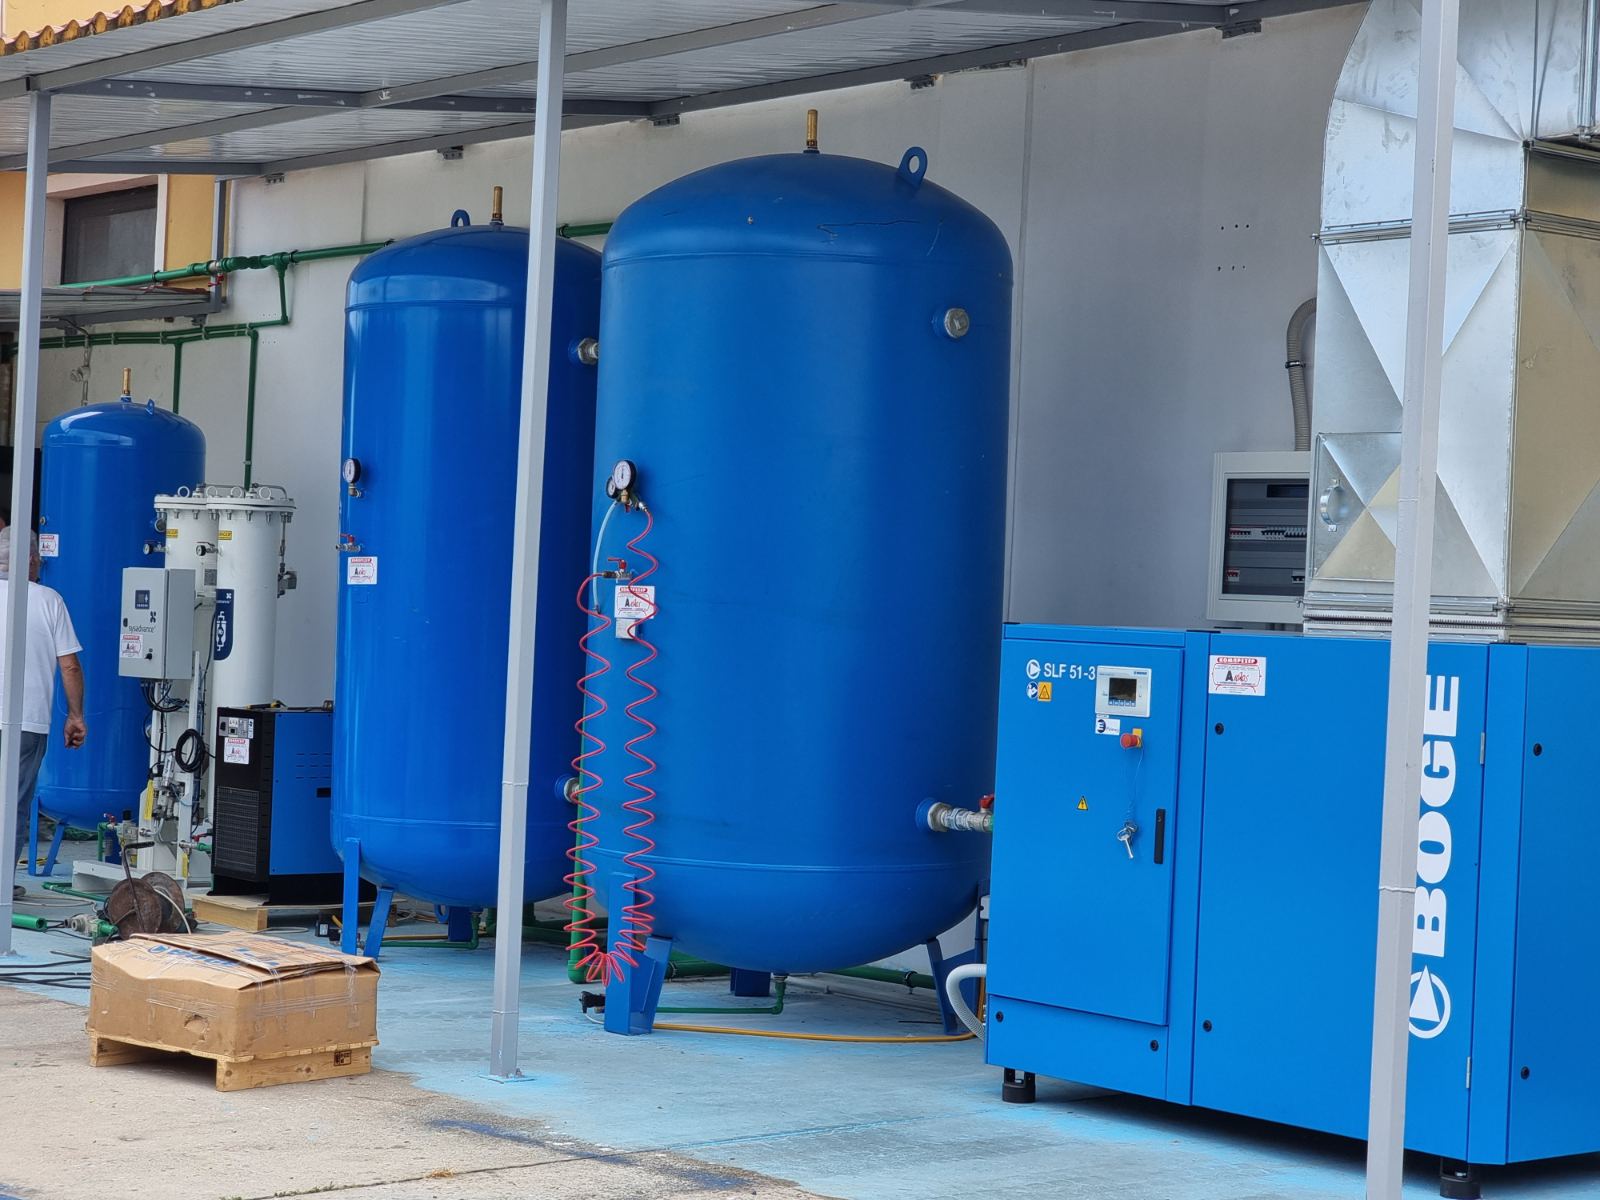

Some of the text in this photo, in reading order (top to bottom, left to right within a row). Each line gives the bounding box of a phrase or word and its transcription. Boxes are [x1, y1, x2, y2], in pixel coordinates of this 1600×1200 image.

[1043, 662, 1096, 680] SLF 51-3
[1411, 674, 1460, 958] BOGE
